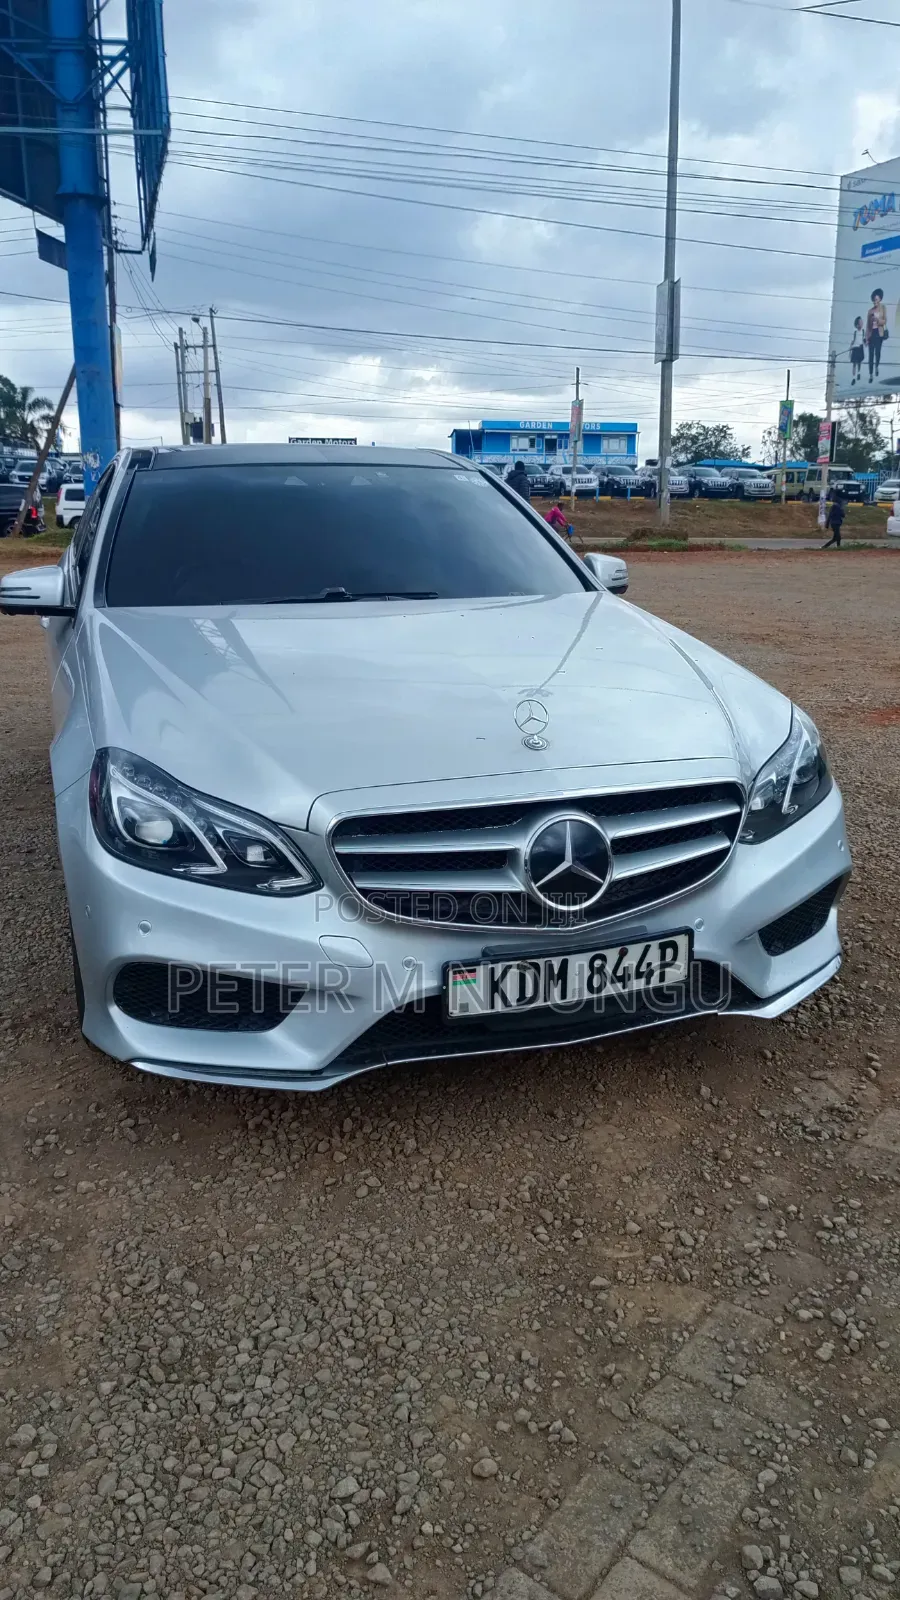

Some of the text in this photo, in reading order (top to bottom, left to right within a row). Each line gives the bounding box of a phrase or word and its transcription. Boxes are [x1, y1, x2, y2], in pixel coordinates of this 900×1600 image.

[519, 421, 553, 430] GARDEN
[324, 438, 356, 446] Motors
[490, 940, 679, 1009] KDM 844P
